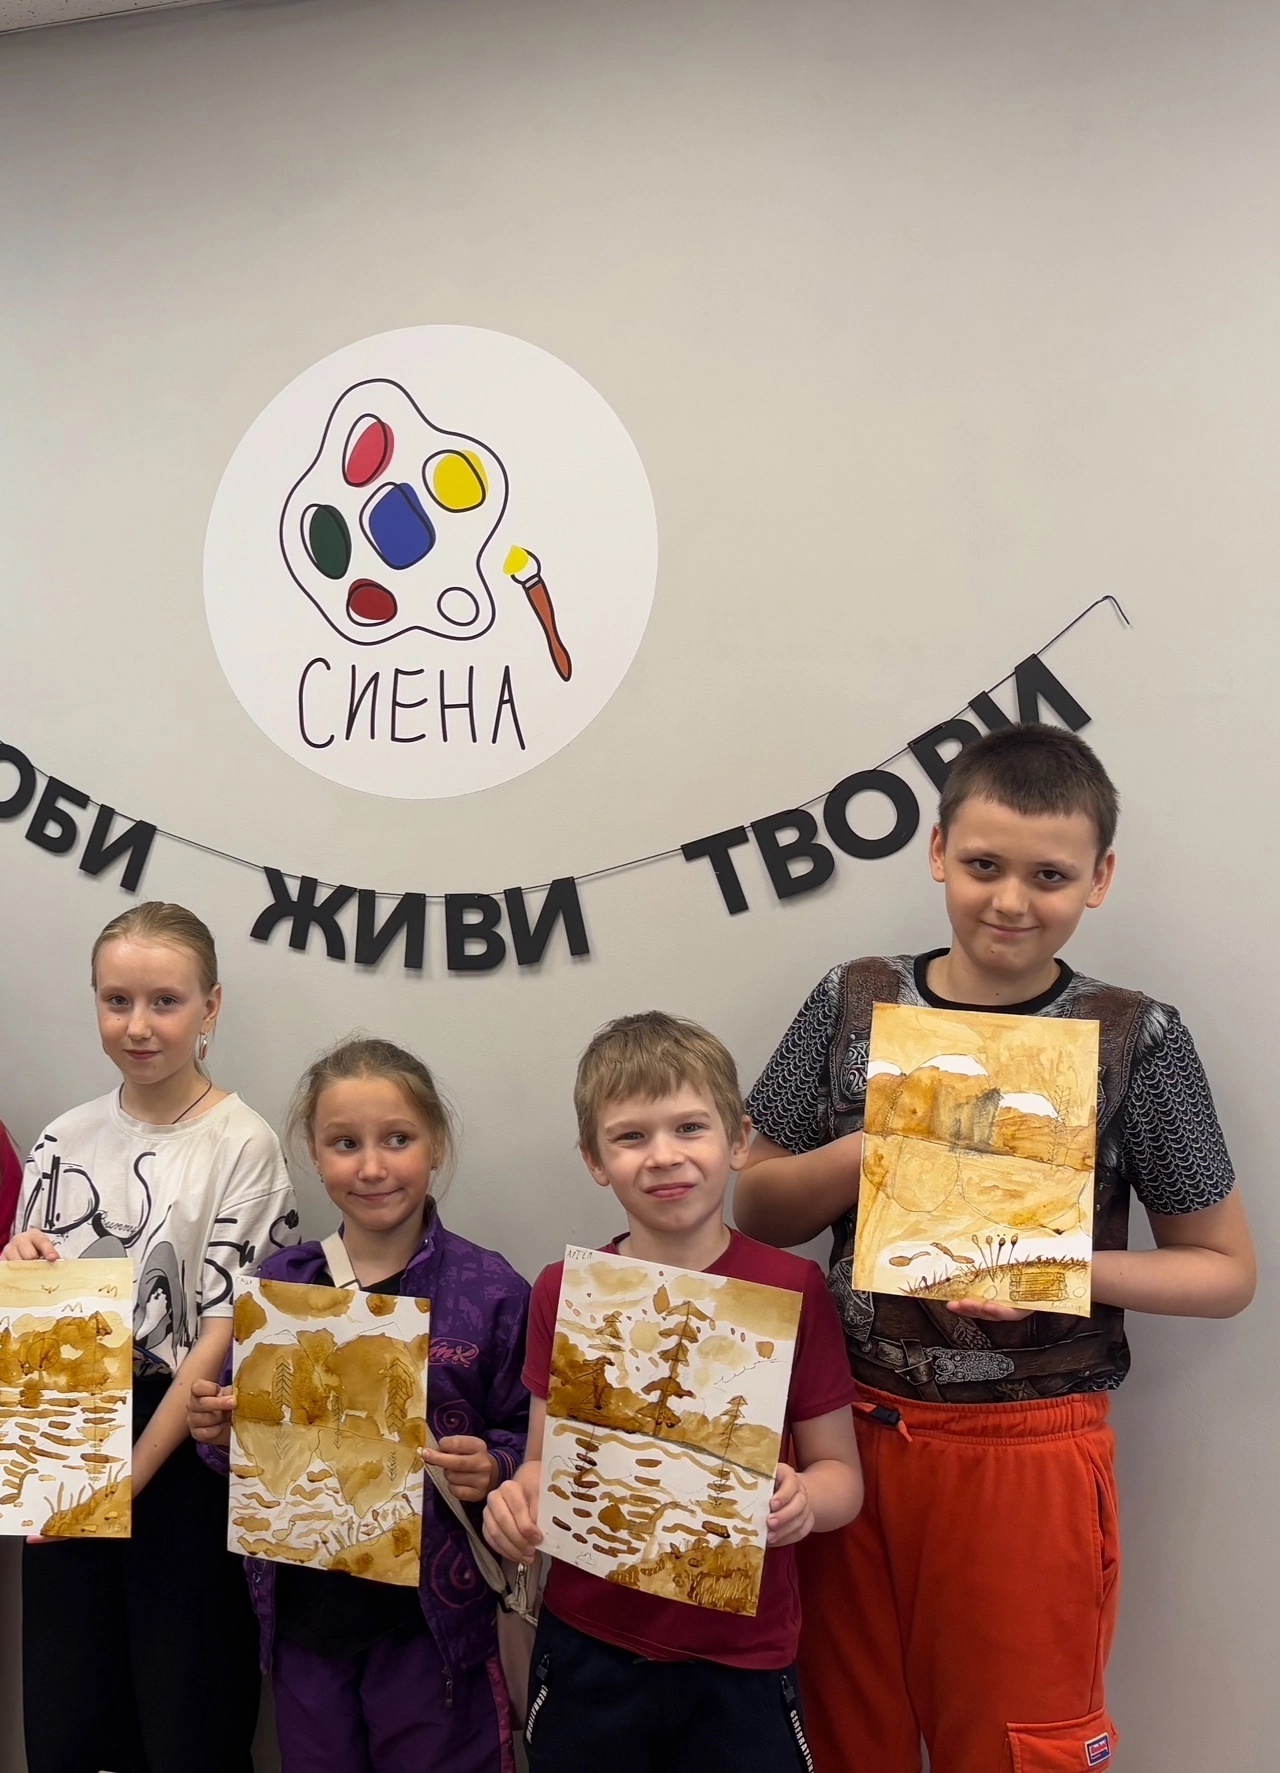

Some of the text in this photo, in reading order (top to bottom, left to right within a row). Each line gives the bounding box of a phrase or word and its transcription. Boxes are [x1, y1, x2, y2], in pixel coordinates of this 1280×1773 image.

[298, 657, 526, 750] СИЕНА
[250, 865, 590, 970] ЖИВИ
[681, 653, 1091, 915] ТВОРИ
